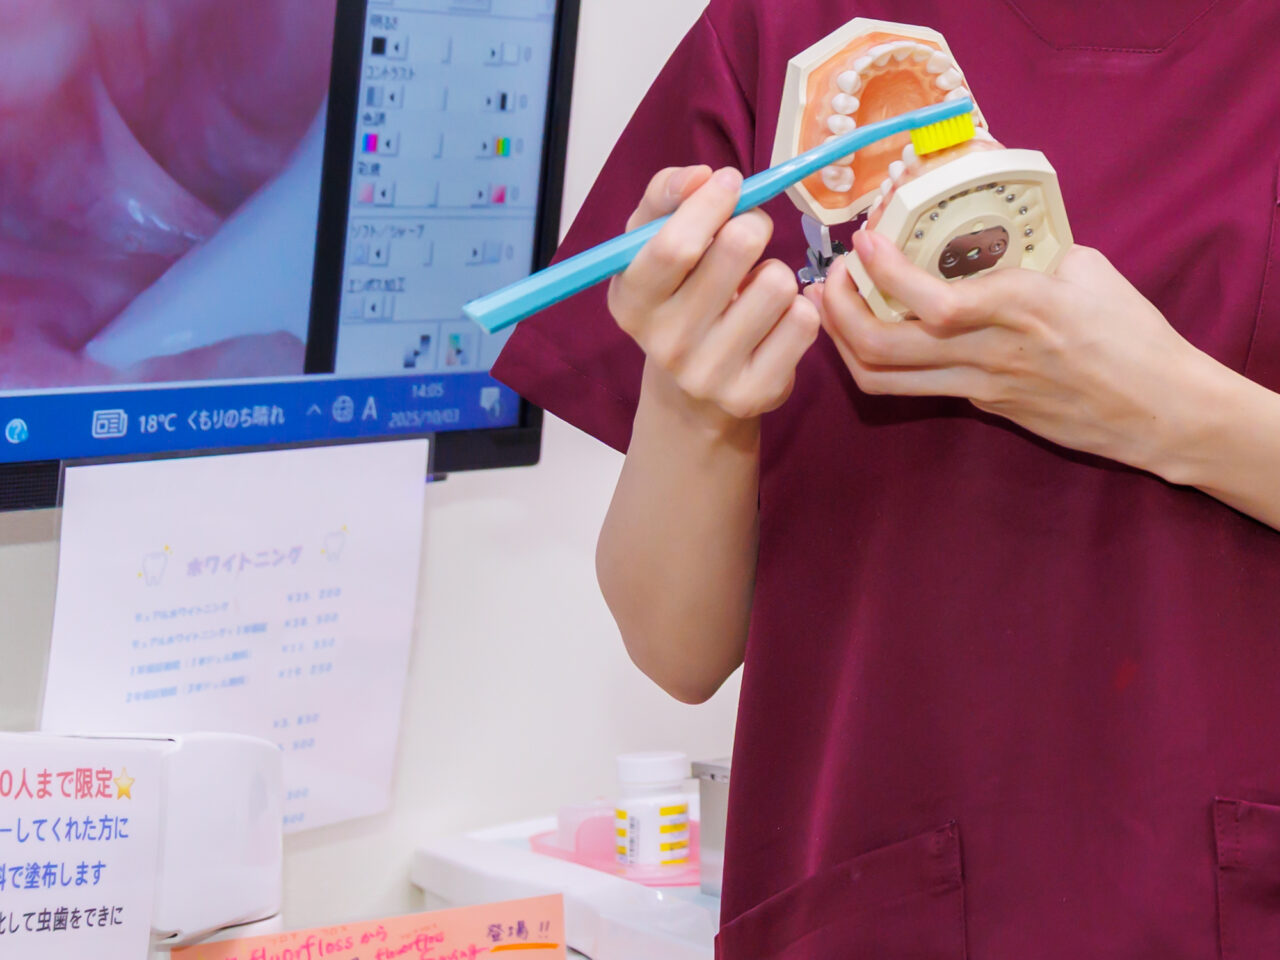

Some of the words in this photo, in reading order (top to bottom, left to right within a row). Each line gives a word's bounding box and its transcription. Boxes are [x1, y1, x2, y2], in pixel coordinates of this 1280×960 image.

[412, 381, 445, 399] 14:05
[186, 404, 286, 432] くもりのち晴れ
[361, 396, 379, 422] A
[186, 544, 304, 578] ホワイトニング
[0, 767, 114, 801] 0人まで限定
